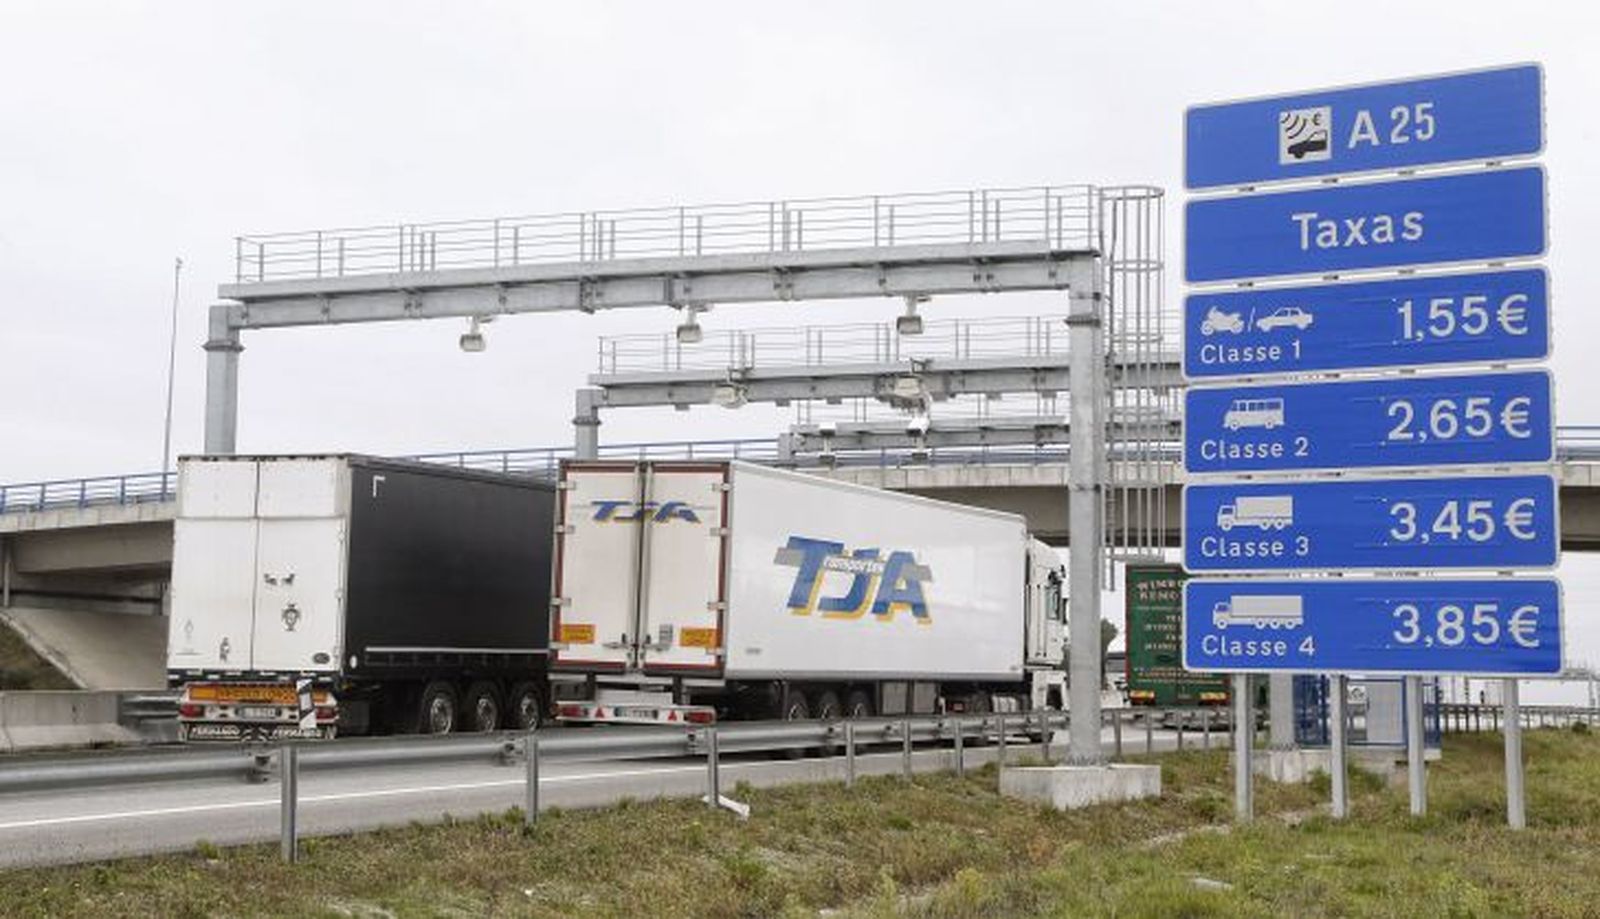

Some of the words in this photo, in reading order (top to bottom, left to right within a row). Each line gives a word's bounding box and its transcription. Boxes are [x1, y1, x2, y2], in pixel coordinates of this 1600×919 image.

[1348, 109, 1380, 149] A
[1390, 102, 1436, 145] 25
[1292, 211, 1424, 250] Taxas
[1200, 344, 1281, 364] Classe
[1291, 339, 1301, 359] 1
[1201, 440, 1284, 460] Classe
[1295, 436, 1309, 457] 2
[1201, 536, 1284, 557] Classe
[1295, 535, 1310, 556] 3
[775, 536, 932, 624] TJA
[1201, 634, 1287, 656] Classe
[1298, 636, 1316, 656] 4
